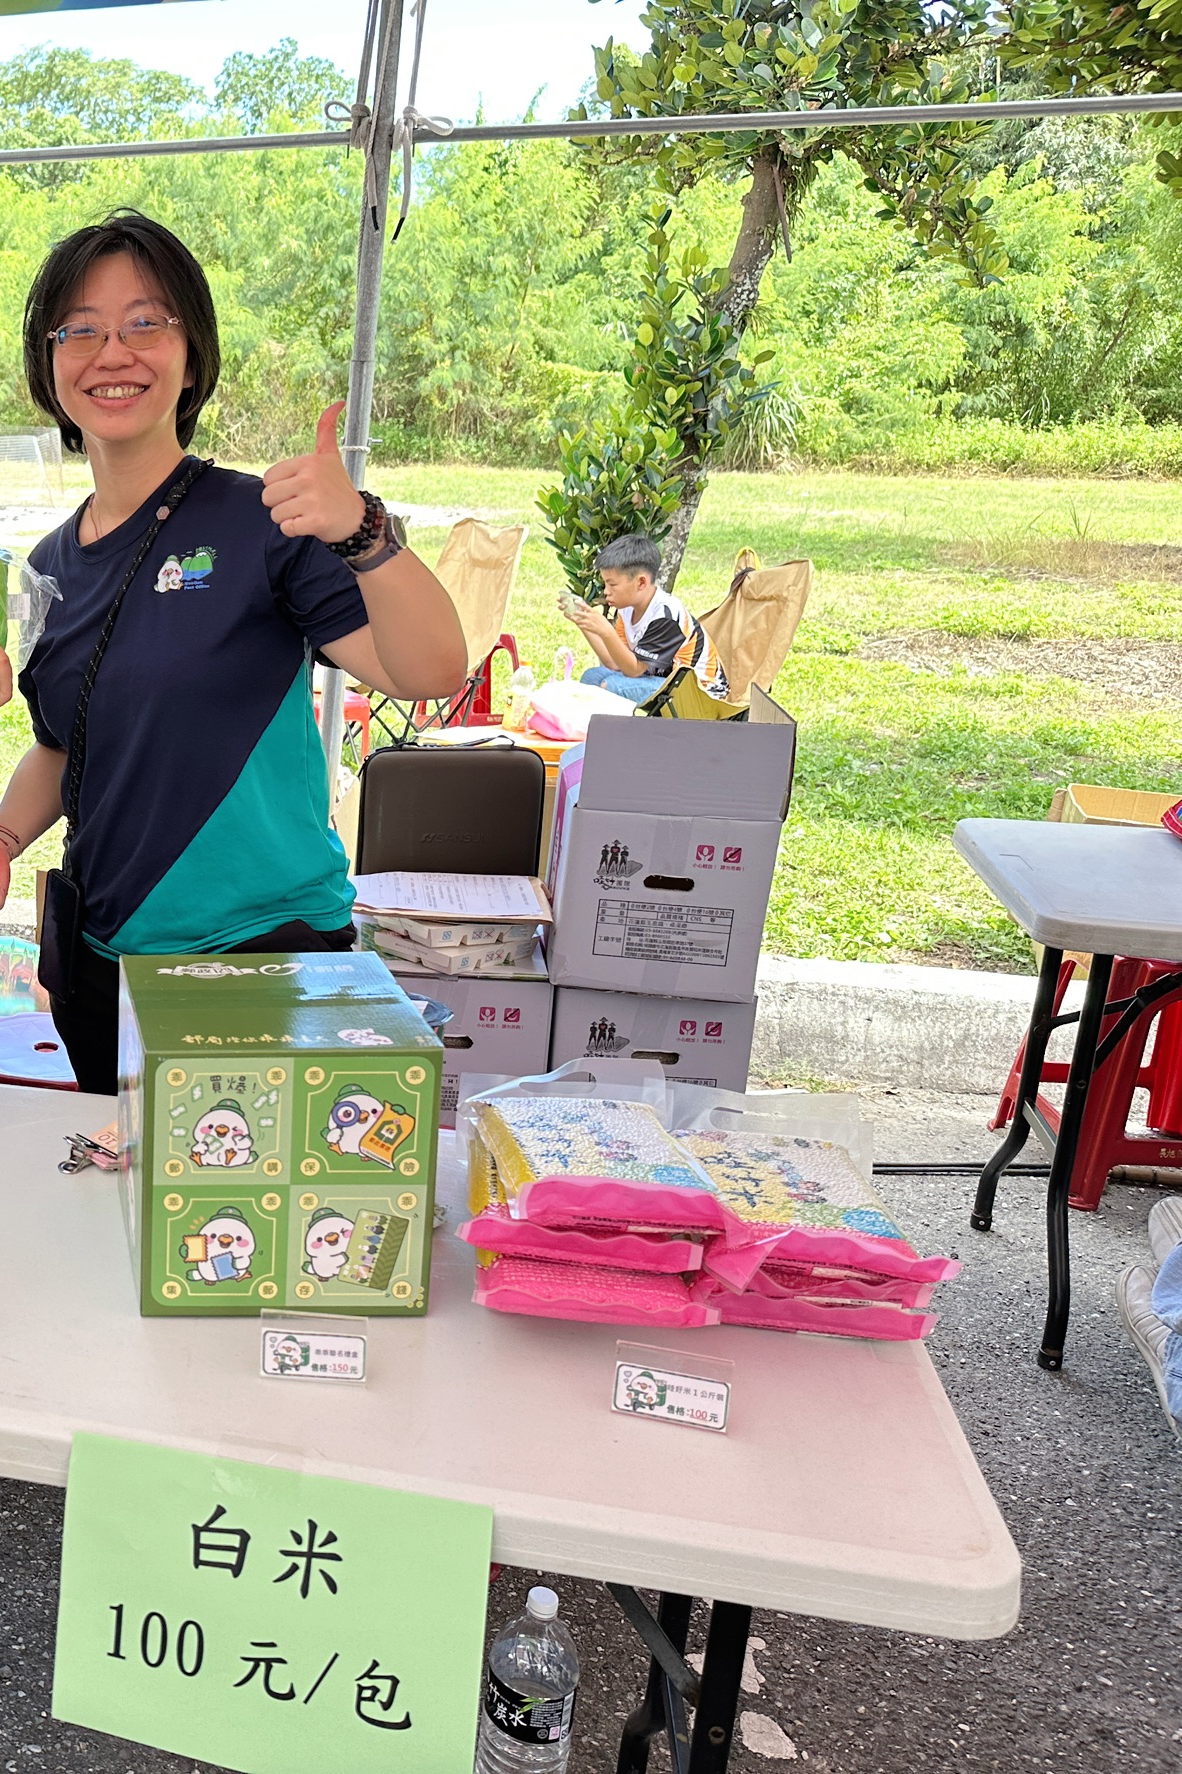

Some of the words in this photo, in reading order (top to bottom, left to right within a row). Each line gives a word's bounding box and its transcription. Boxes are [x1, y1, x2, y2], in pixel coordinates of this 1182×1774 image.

[303, 1160, 316, 1173] 保
[165, 1283, 178, 1296] 集
[298, 1284, 311, 1296] 存
[191, 1503, 344, 1600] 白米
[106, 1603, 205, 1678] 100
